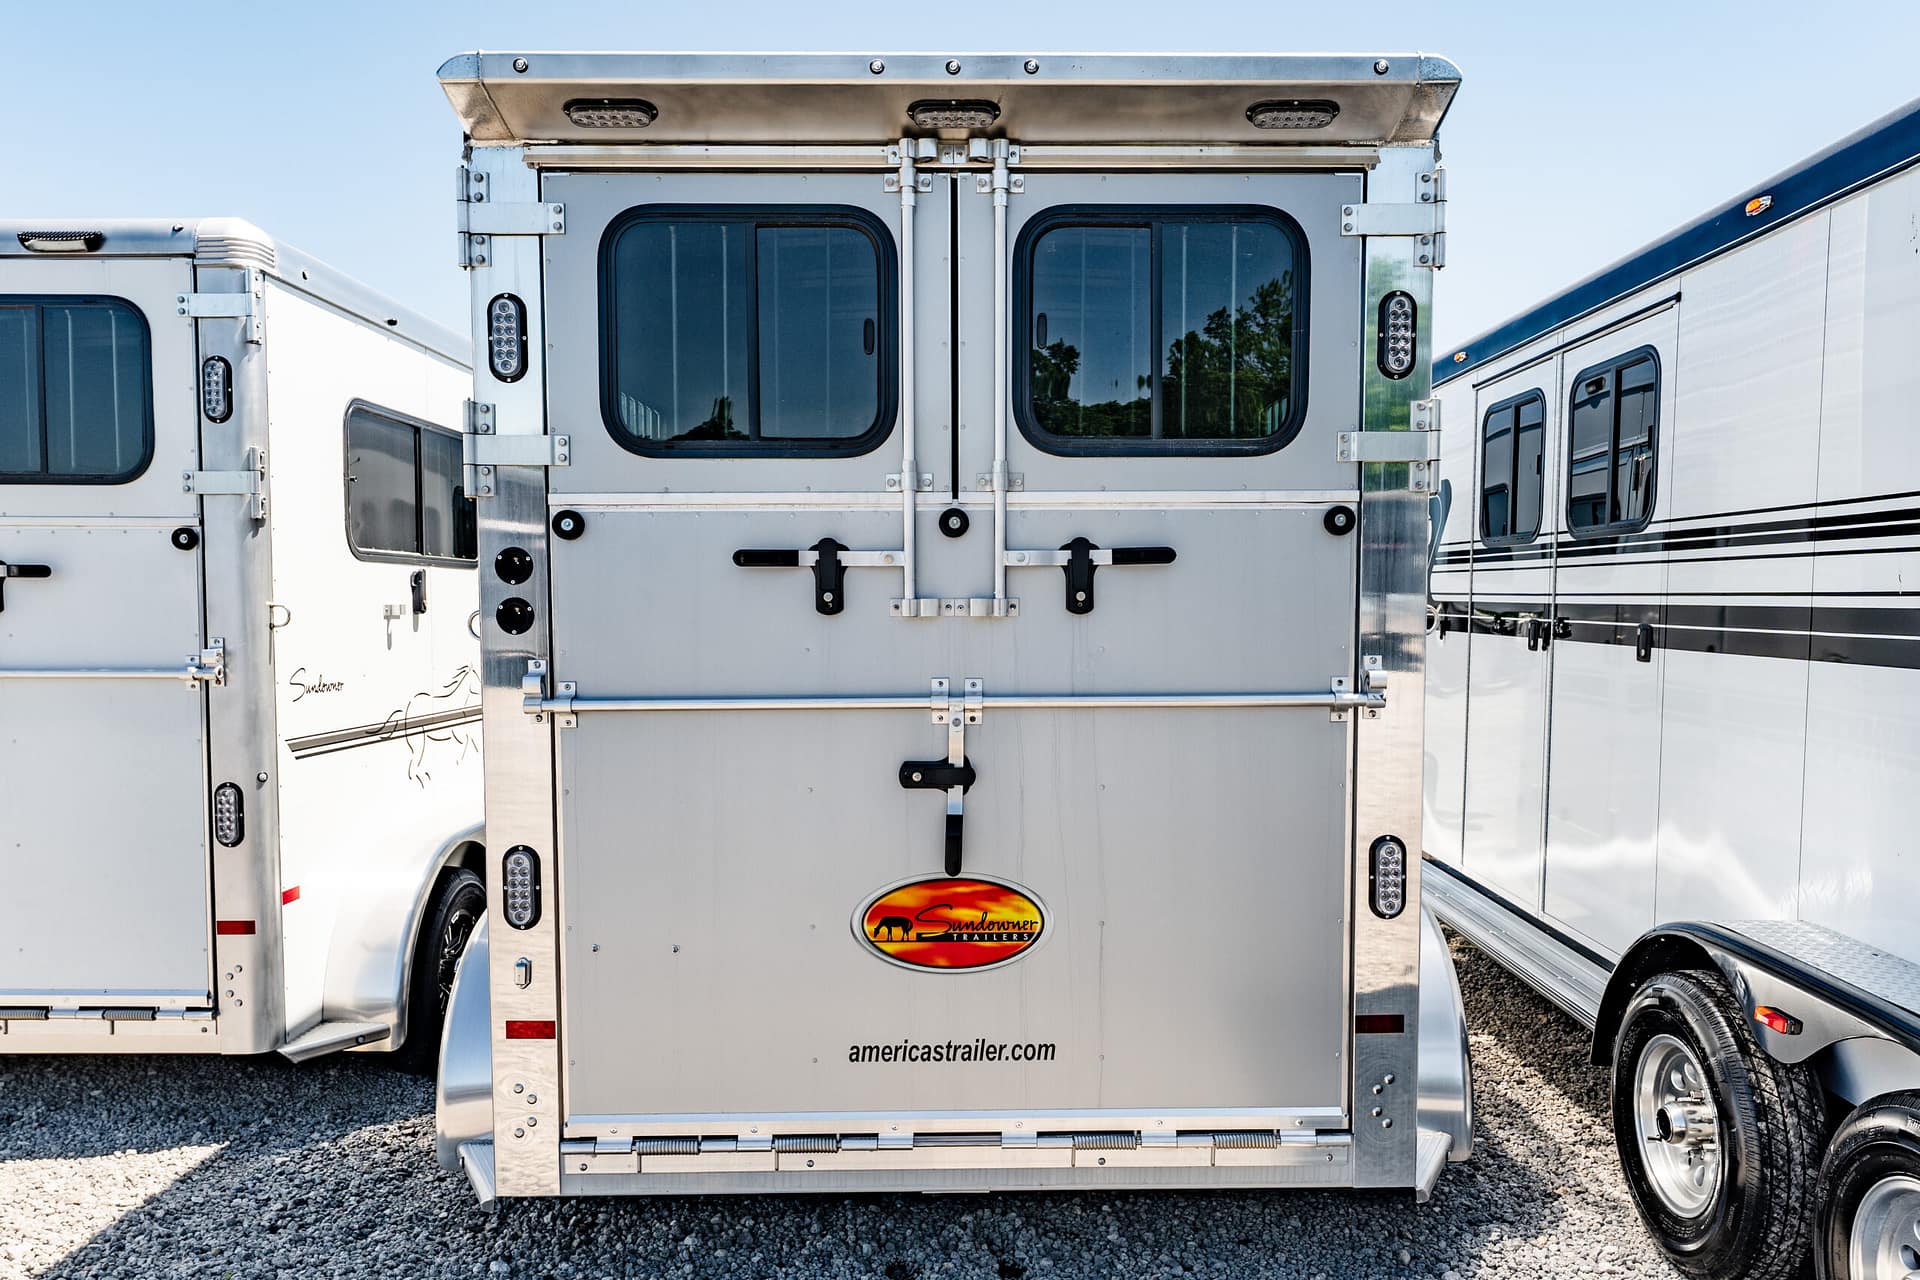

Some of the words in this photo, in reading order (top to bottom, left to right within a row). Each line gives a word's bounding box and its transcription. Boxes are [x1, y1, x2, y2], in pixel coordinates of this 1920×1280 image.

[289, 667, 344, 702] Sundowner
[915, 903, 1039, 937] Sundowner
[953, 933, 1029, 941] TRAILERS
[849, 1038, 1056, 1062] americastrailer.com
